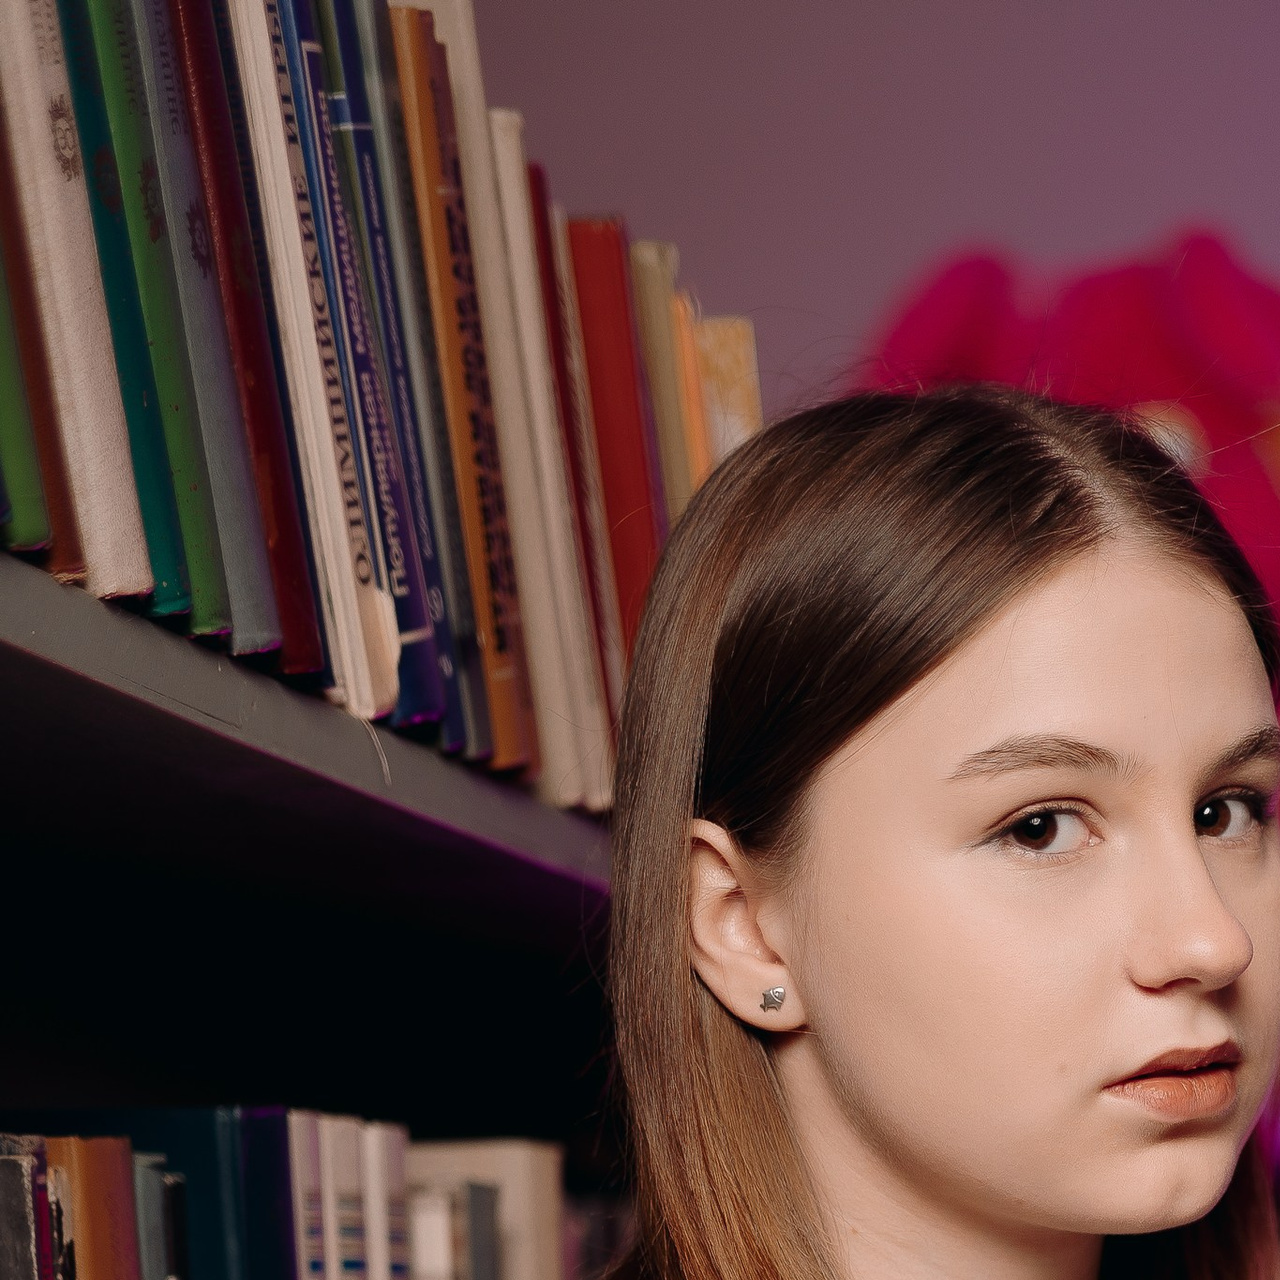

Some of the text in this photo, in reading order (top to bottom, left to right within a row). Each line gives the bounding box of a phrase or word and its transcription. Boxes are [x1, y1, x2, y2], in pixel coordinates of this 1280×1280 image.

[265, 1, 371, 585] ОЛИМПИЙСКИЕ ИГРЫ
[360, 372, 411, 598] Популярная
